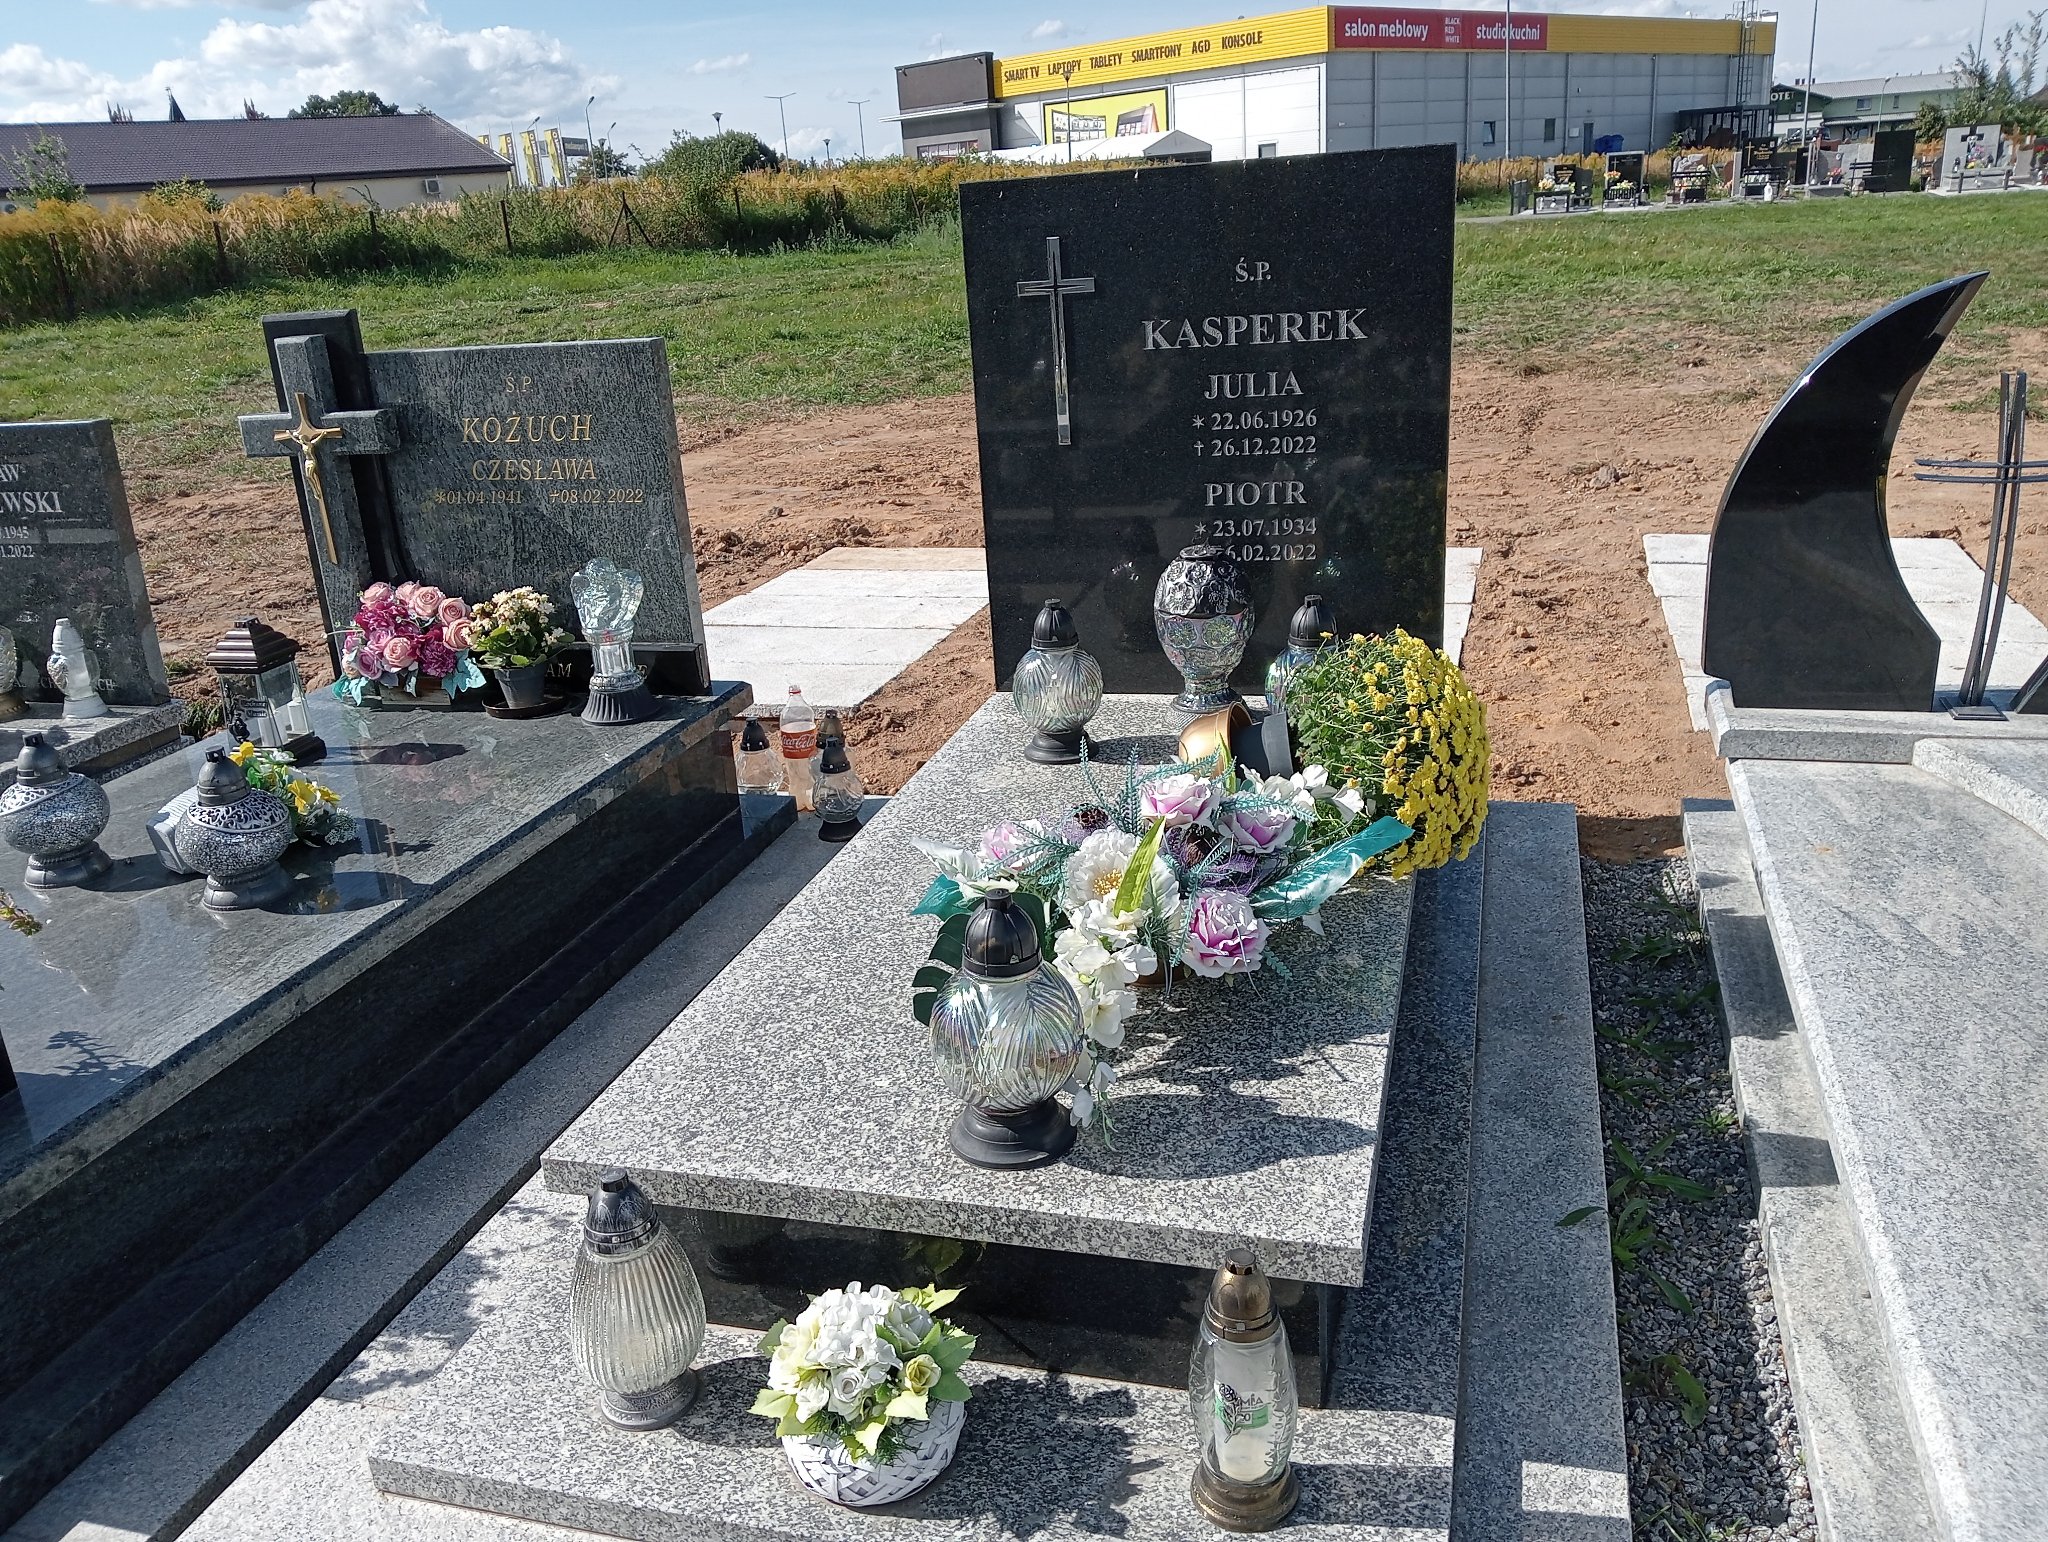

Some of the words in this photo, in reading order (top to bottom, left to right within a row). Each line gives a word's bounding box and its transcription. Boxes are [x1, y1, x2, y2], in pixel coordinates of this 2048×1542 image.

[1345, 18, 1376, 37] salon
[1379, 20, 1428, 41] meblowy
[1476, 23, 1507, 40] studio
[1509, 23, 1540, 40] kuchni
[1004, 67, 1029, 83] SMART
[1030, 65, 1039, 79] TV
[1047, 59, 1081, 75] LAPTOPY
[1090, 52, 1123, 70] TABLETY
[1131, 43, 1182, 63] SMARTFONY
[1191, 39, 1211, 54] AGD
[1221, 30, 1263, 50] KONSOLE
[1235, 257, 1272, 283] Ś.P.
[1141, 308, 1368, 350] KASPEREK
[1204, 370, 1304, 400] JULIA
[461, 410, 593, 443] KOŻUCH
[1211, 408, 1317, 430] 22.06.1926
[1211, 435, 1317, 457] 26.12.2022
[472, 458, 597, 481] CZESŁAWA
[0, 491, 64, 513] WSKI
[1204, 480, 1307, 506] PIOTR
[1212, 517, 1317, 538] 23.07.1934
